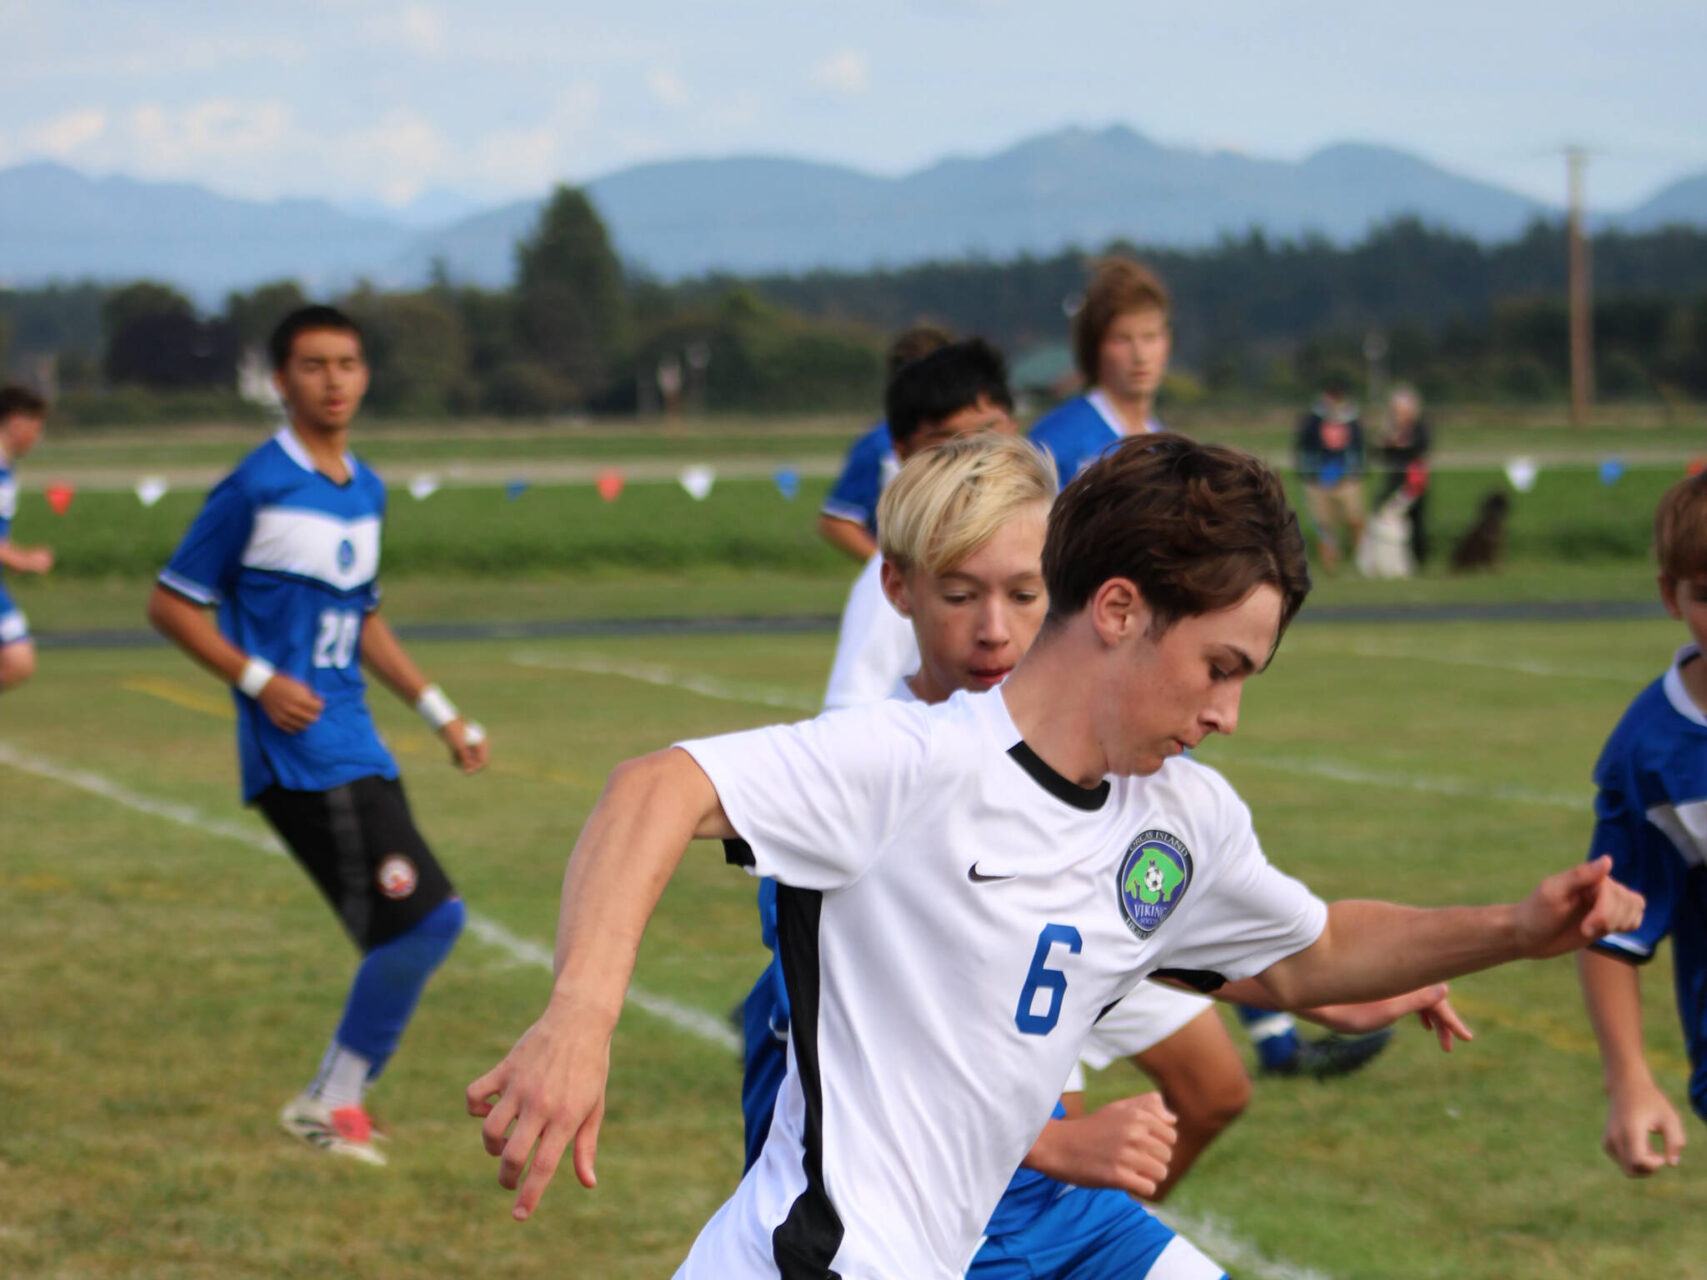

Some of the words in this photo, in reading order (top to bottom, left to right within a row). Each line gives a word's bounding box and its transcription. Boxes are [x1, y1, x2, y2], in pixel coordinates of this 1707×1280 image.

[312, 610, 359, 669] 20
[1155, 831, 1189, 857] ISLAND
[1014, 922, 1083, 1037] 6
